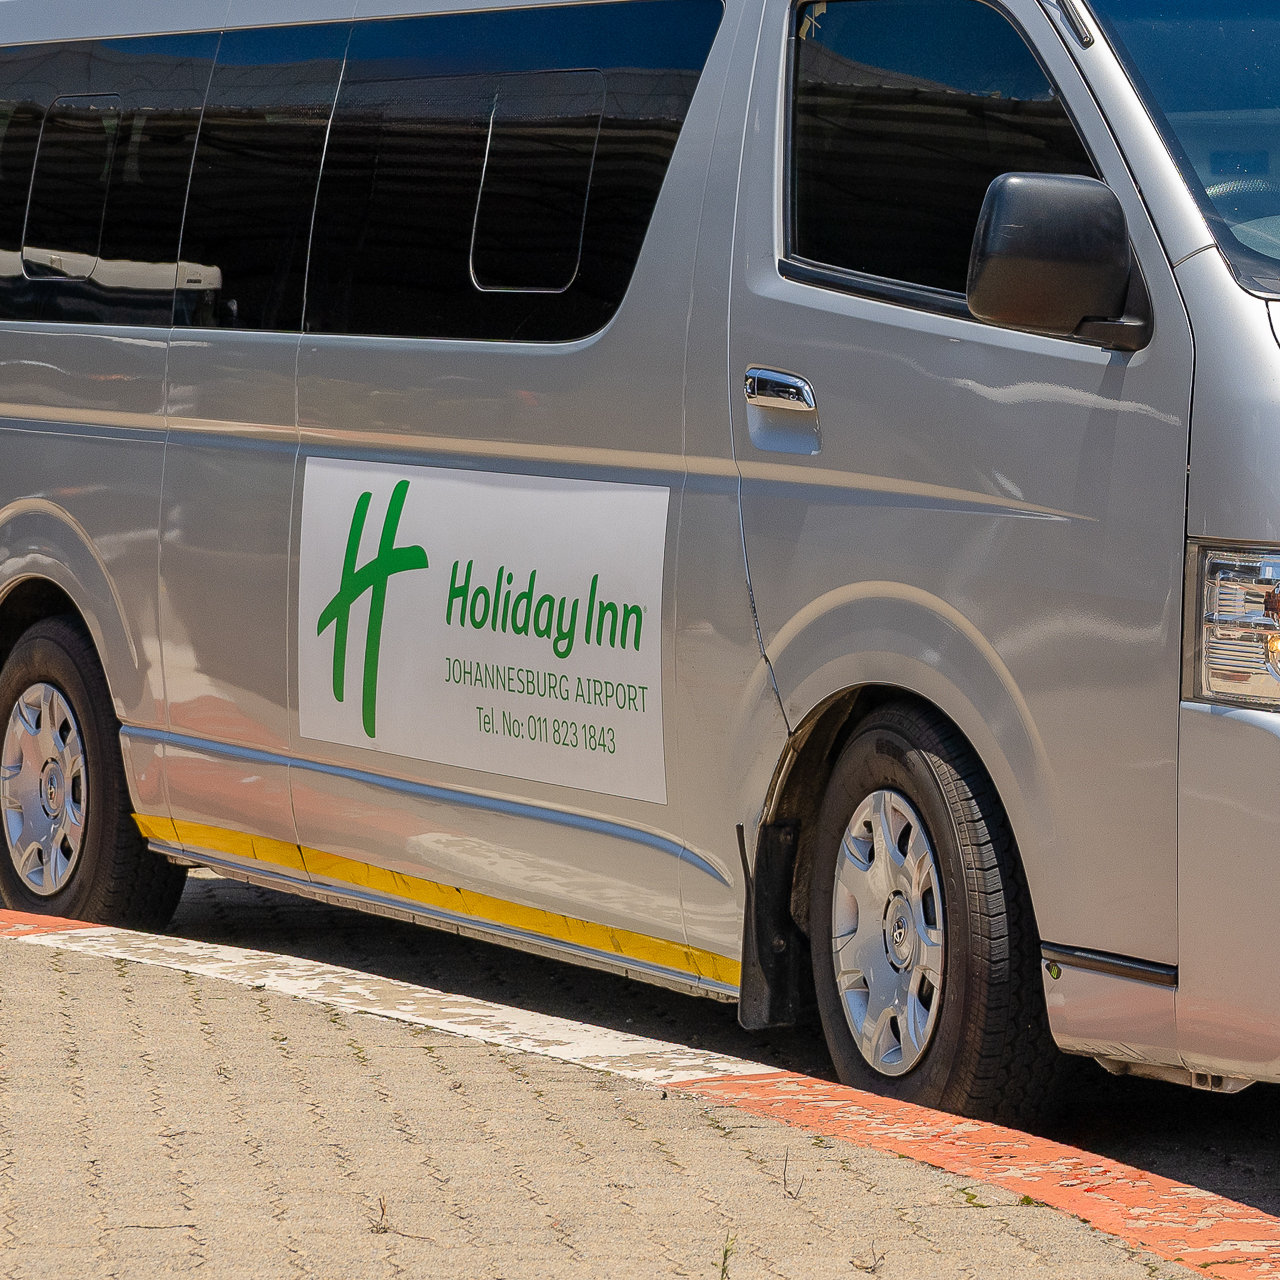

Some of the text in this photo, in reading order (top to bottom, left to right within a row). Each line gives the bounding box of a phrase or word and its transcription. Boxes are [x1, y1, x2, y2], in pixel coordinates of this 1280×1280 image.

[446, 560, 643, 659] Holiday Inn
[445, 657, 648, 712] JOHANNESBURG AIRPORT
[476, 707, 616, 754] Tel. No: 011 823 1843
